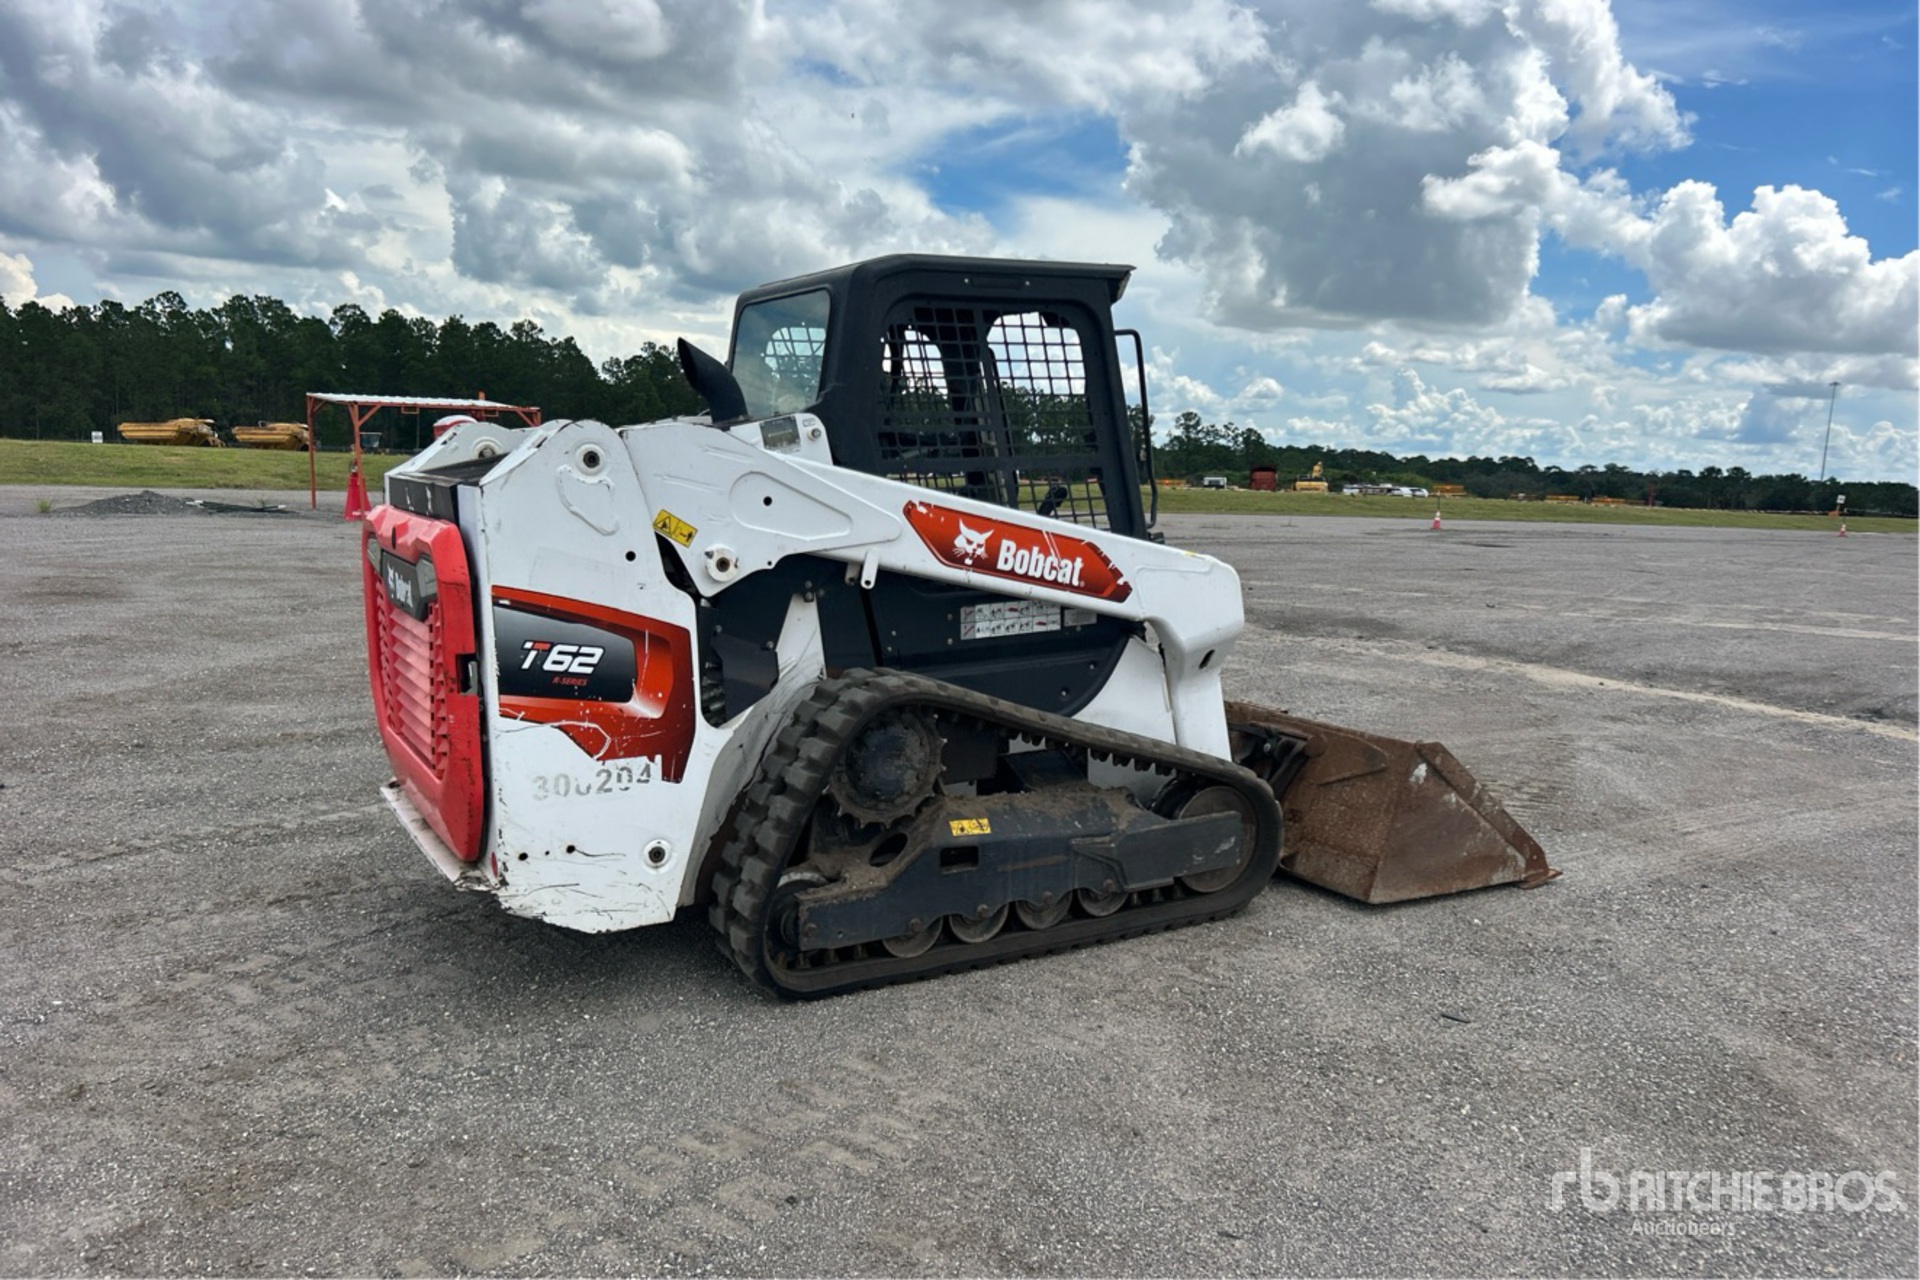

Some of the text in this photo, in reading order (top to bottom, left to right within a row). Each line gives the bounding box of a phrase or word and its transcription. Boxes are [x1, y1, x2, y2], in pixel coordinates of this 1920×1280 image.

[997, 539, 1084, 586] Bobcat
[521, 641, 604, 674] T62
[552, 676, 589, 687] R-SERIES
